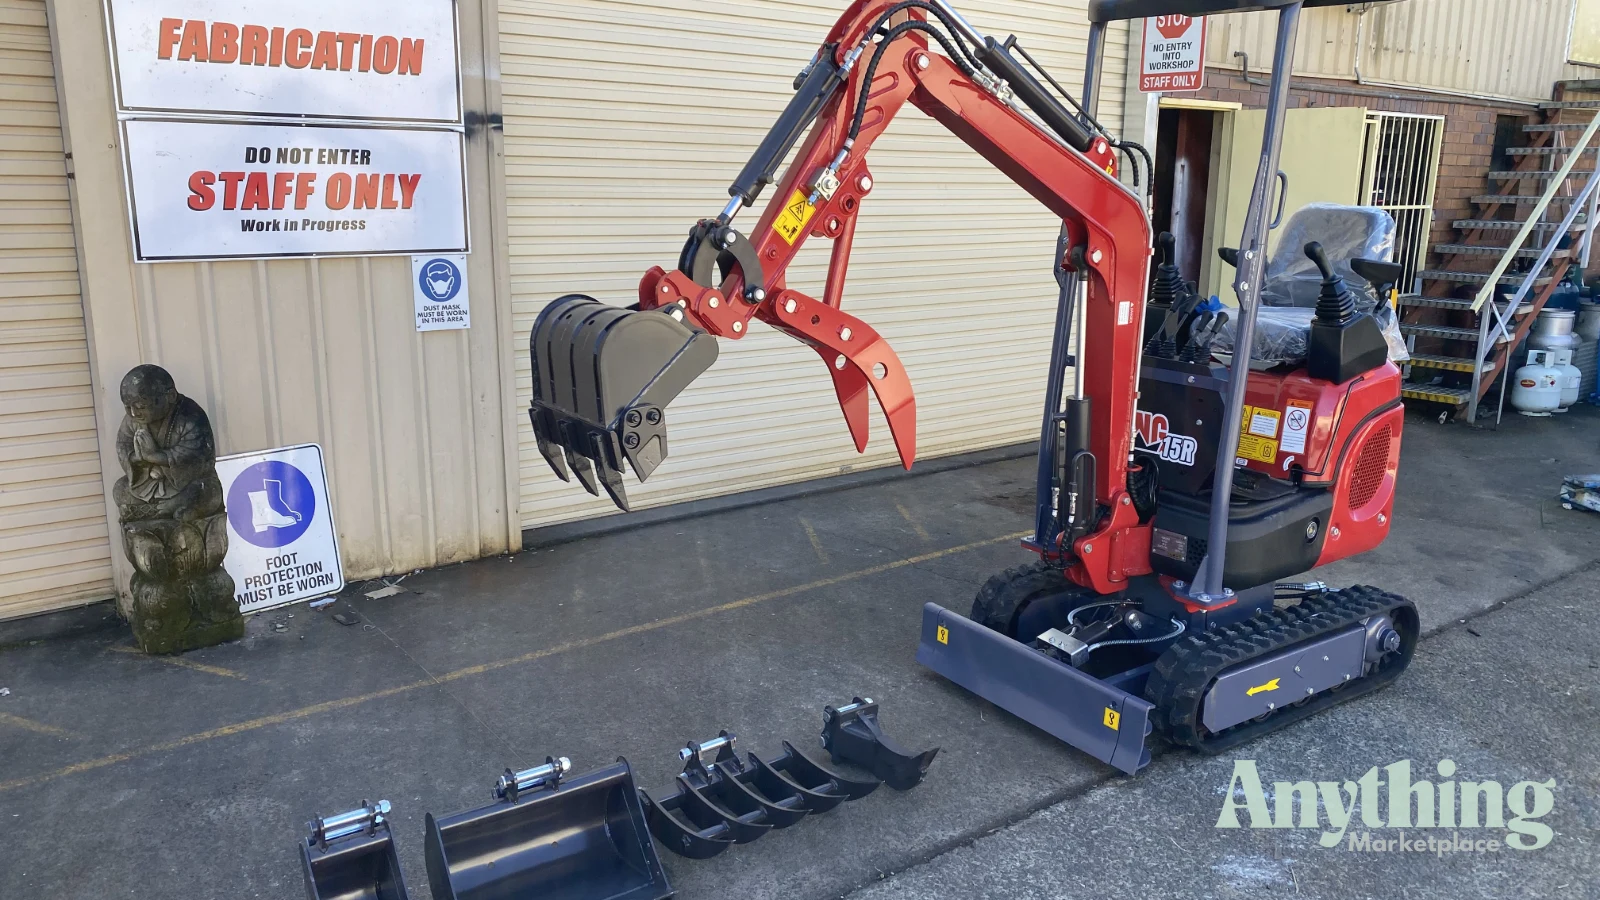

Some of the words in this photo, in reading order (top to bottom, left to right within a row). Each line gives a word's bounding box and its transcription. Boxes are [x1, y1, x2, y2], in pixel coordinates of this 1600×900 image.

[158, 17, 425, 76] FABRICATION
[1153, 44, 1164, 52] NO
[1166, 42, 1192, 51] ENTRY
[1149, 60, 1194, 70] WORKSHOP
[1162, 52, 1181, 60] INTO
[1144, 76, 1171, 88] STAFF
[1172, 75, 1197, 87] ONLY
[245, 147, 271, 165] DO
[276, 147, 314, 165] NOT
[317, 149, 371, 166] ENTER
[187, 170, 317, 212] STAFF
[325, 172, 422, 211] ONLY
[241, 219, 281, 232] Work
[284, 218, 298, 231] in
[301, 218, 366, 233] Progress
[1161, 435, 1196, 464] 15R
[265, 552, 298, 570] FOOT
[244, 561, 323, 589] PROTECTION
[237, 586, 274, 606] MUST
[278, 583, 295, 597] BE
[297, 572, 334, 592] WORN
